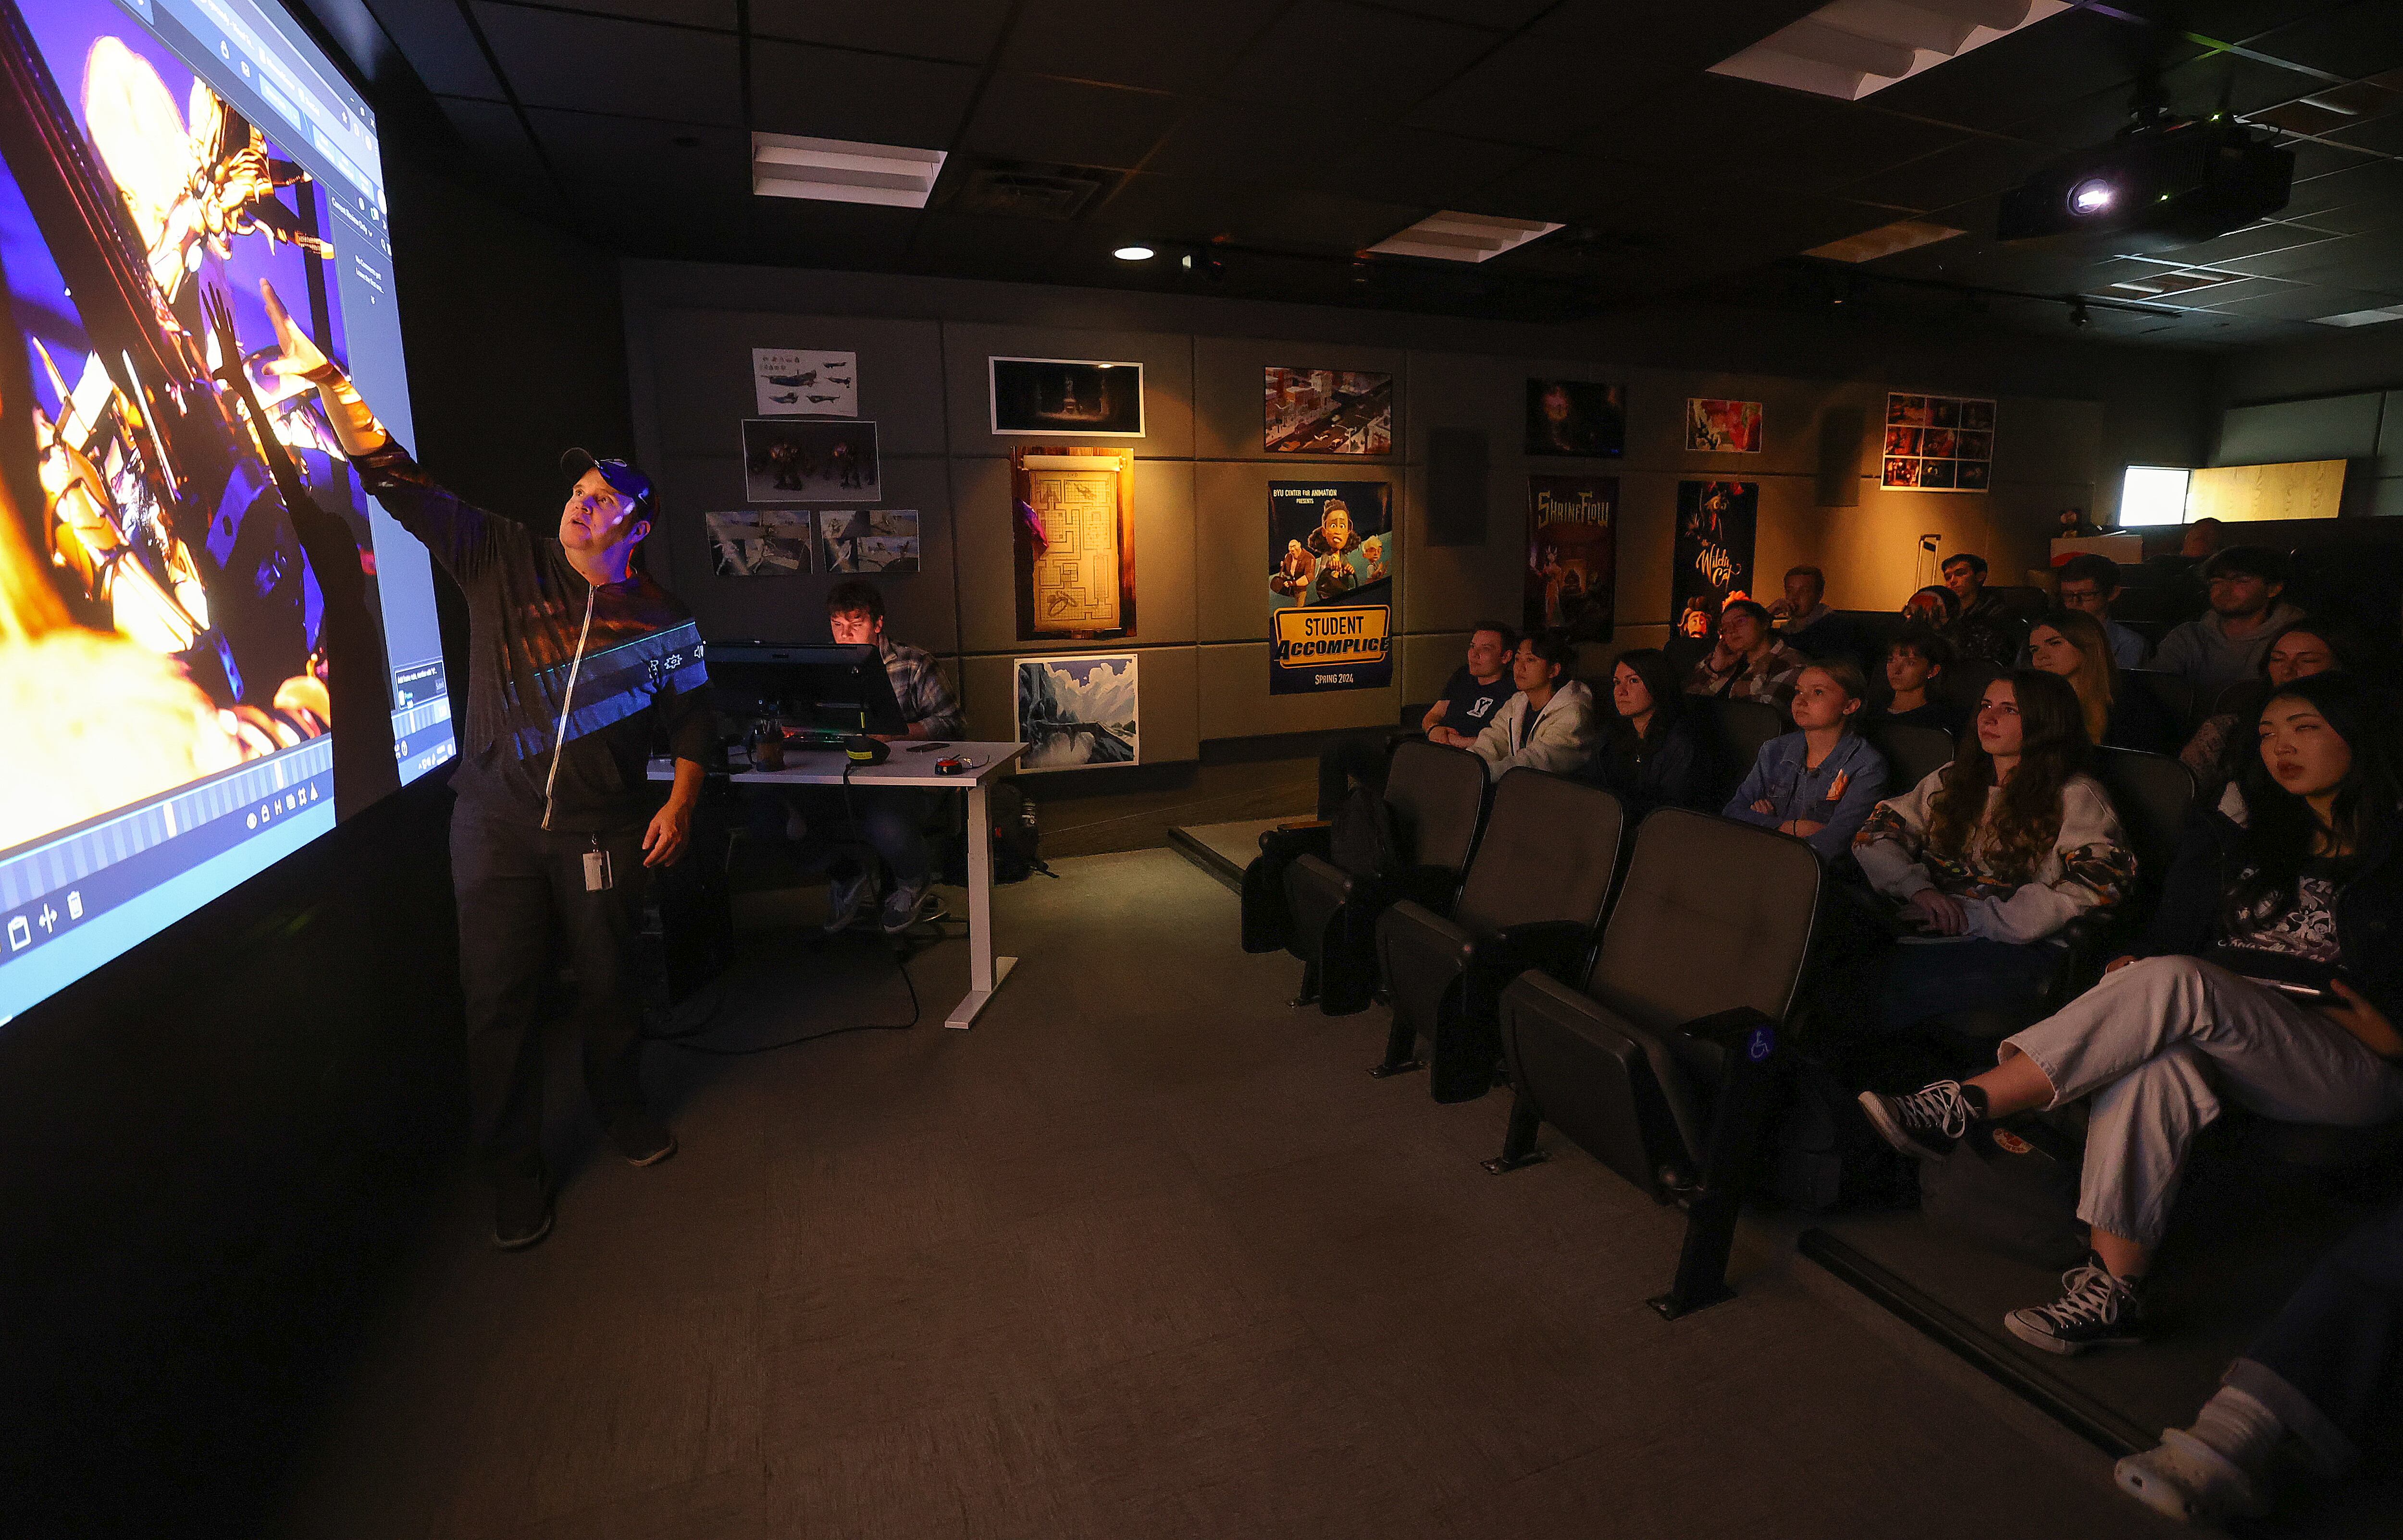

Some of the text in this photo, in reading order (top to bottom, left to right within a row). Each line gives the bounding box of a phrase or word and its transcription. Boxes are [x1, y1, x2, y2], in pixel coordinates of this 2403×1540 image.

[1312, 489, 1337, 497] ANIMATION
[1305, 616, 1364, 636] STUDENT
[1314, 673, 1353, 685] SPRING 2024
